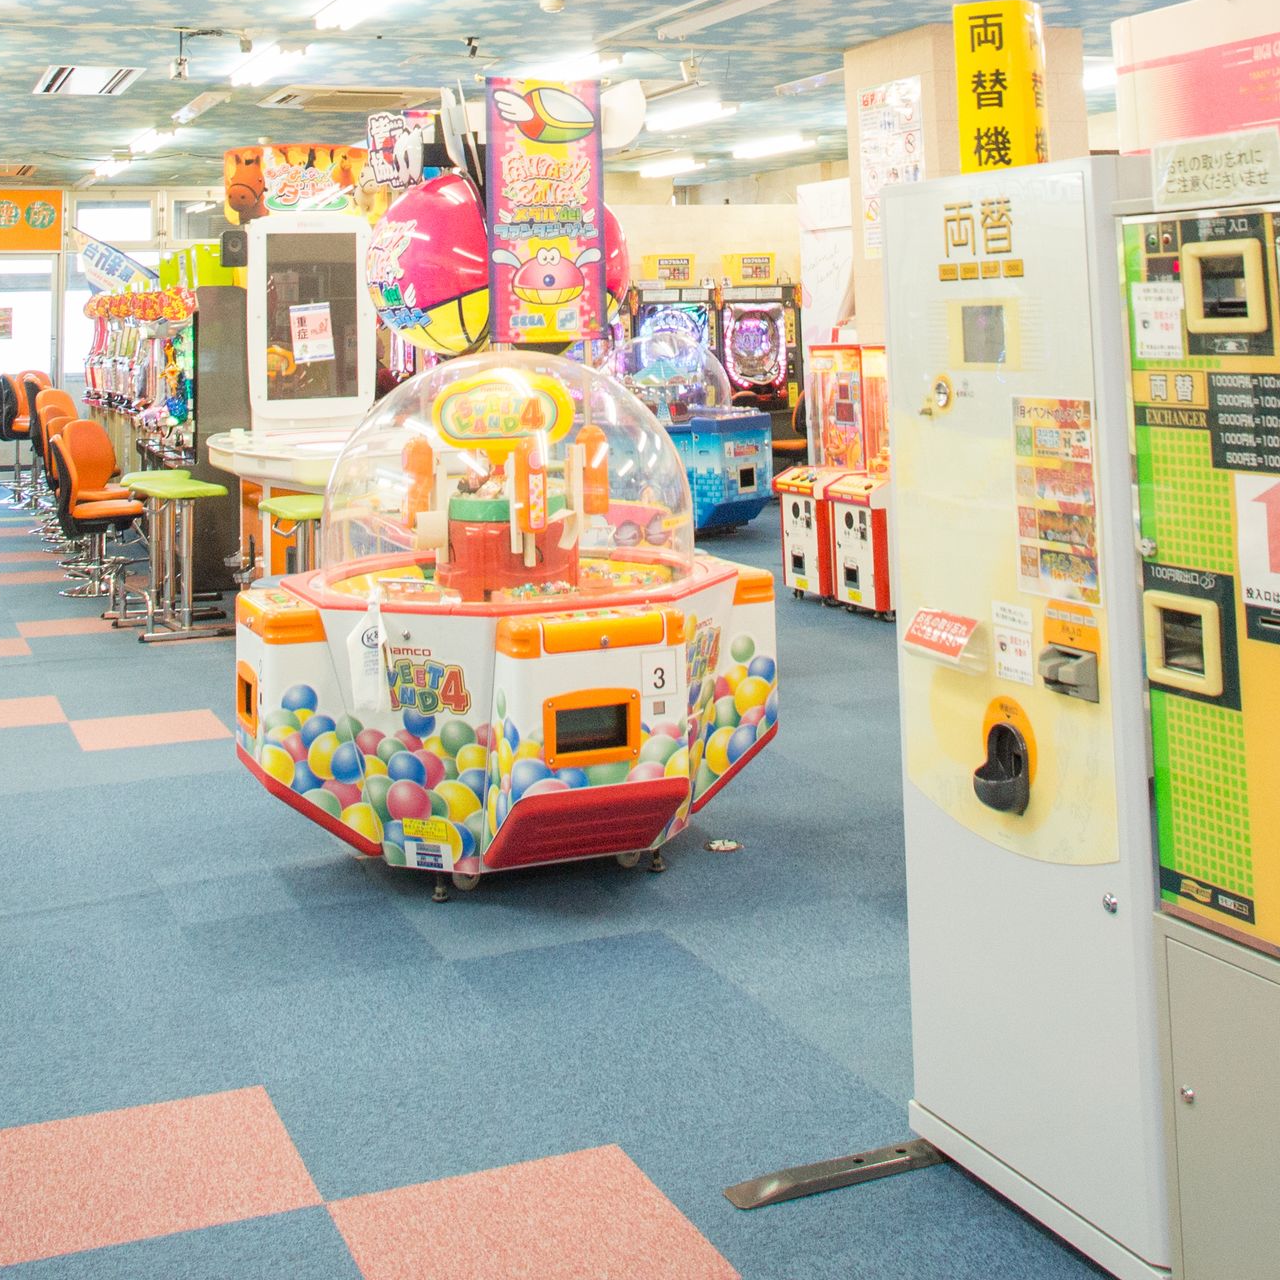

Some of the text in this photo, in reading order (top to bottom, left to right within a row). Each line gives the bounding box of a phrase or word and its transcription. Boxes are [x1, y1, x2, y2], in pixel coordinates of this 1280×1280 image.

[968, 12, 1013, 167] 両替機
[501, 152, 591, 190] FANTASY
[943, 197, 1014, 258] 両替
[1228, 218, 1249, 233] 入口
[510, 313, 546, 328] SEGA
[1149, 373, 1194, 402] 両替
[454, 395, 524, 419] SWEET
[520, 397, 546, 431] 4
[1145, 407, 1208, 428] EXCHANGER
[452, 413, 520, 434] LAND
[387, 661, 445, 690] EET
[439, 667, 468, 713] 4
[652, 666, 666, 690] 3
